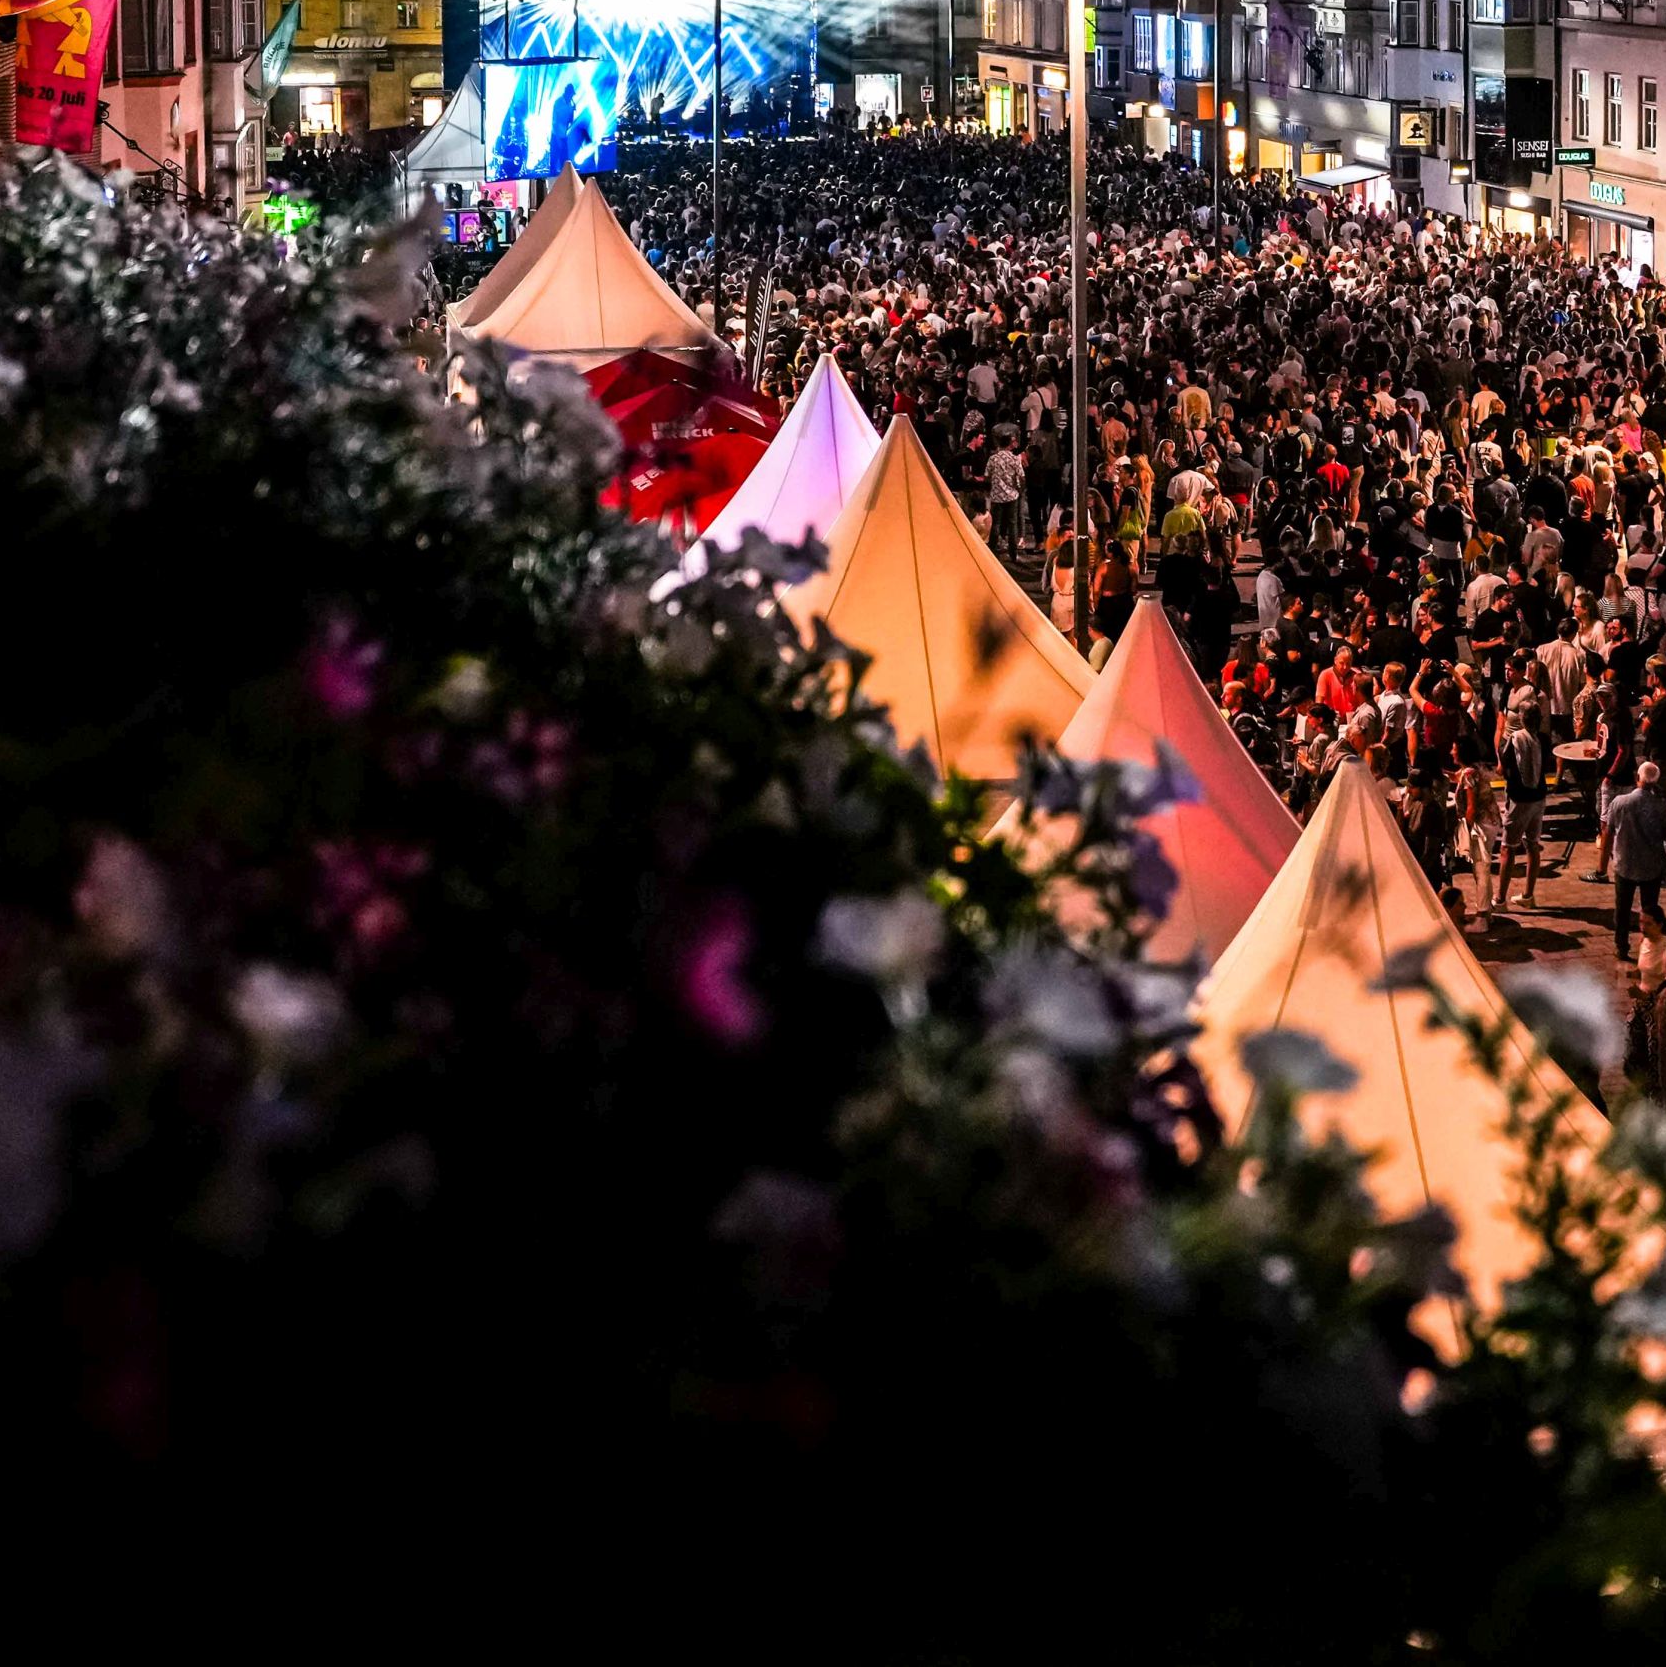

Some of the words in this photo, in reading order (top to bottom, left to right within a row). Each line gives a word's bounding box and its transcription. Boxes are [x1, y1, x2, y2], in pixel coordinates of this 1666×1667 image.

[60, 90, 86, 106] Juli
[1517, 140, 1550, 152] SENSEI
[1558, 152, 1590, 162] DOUGLAS
